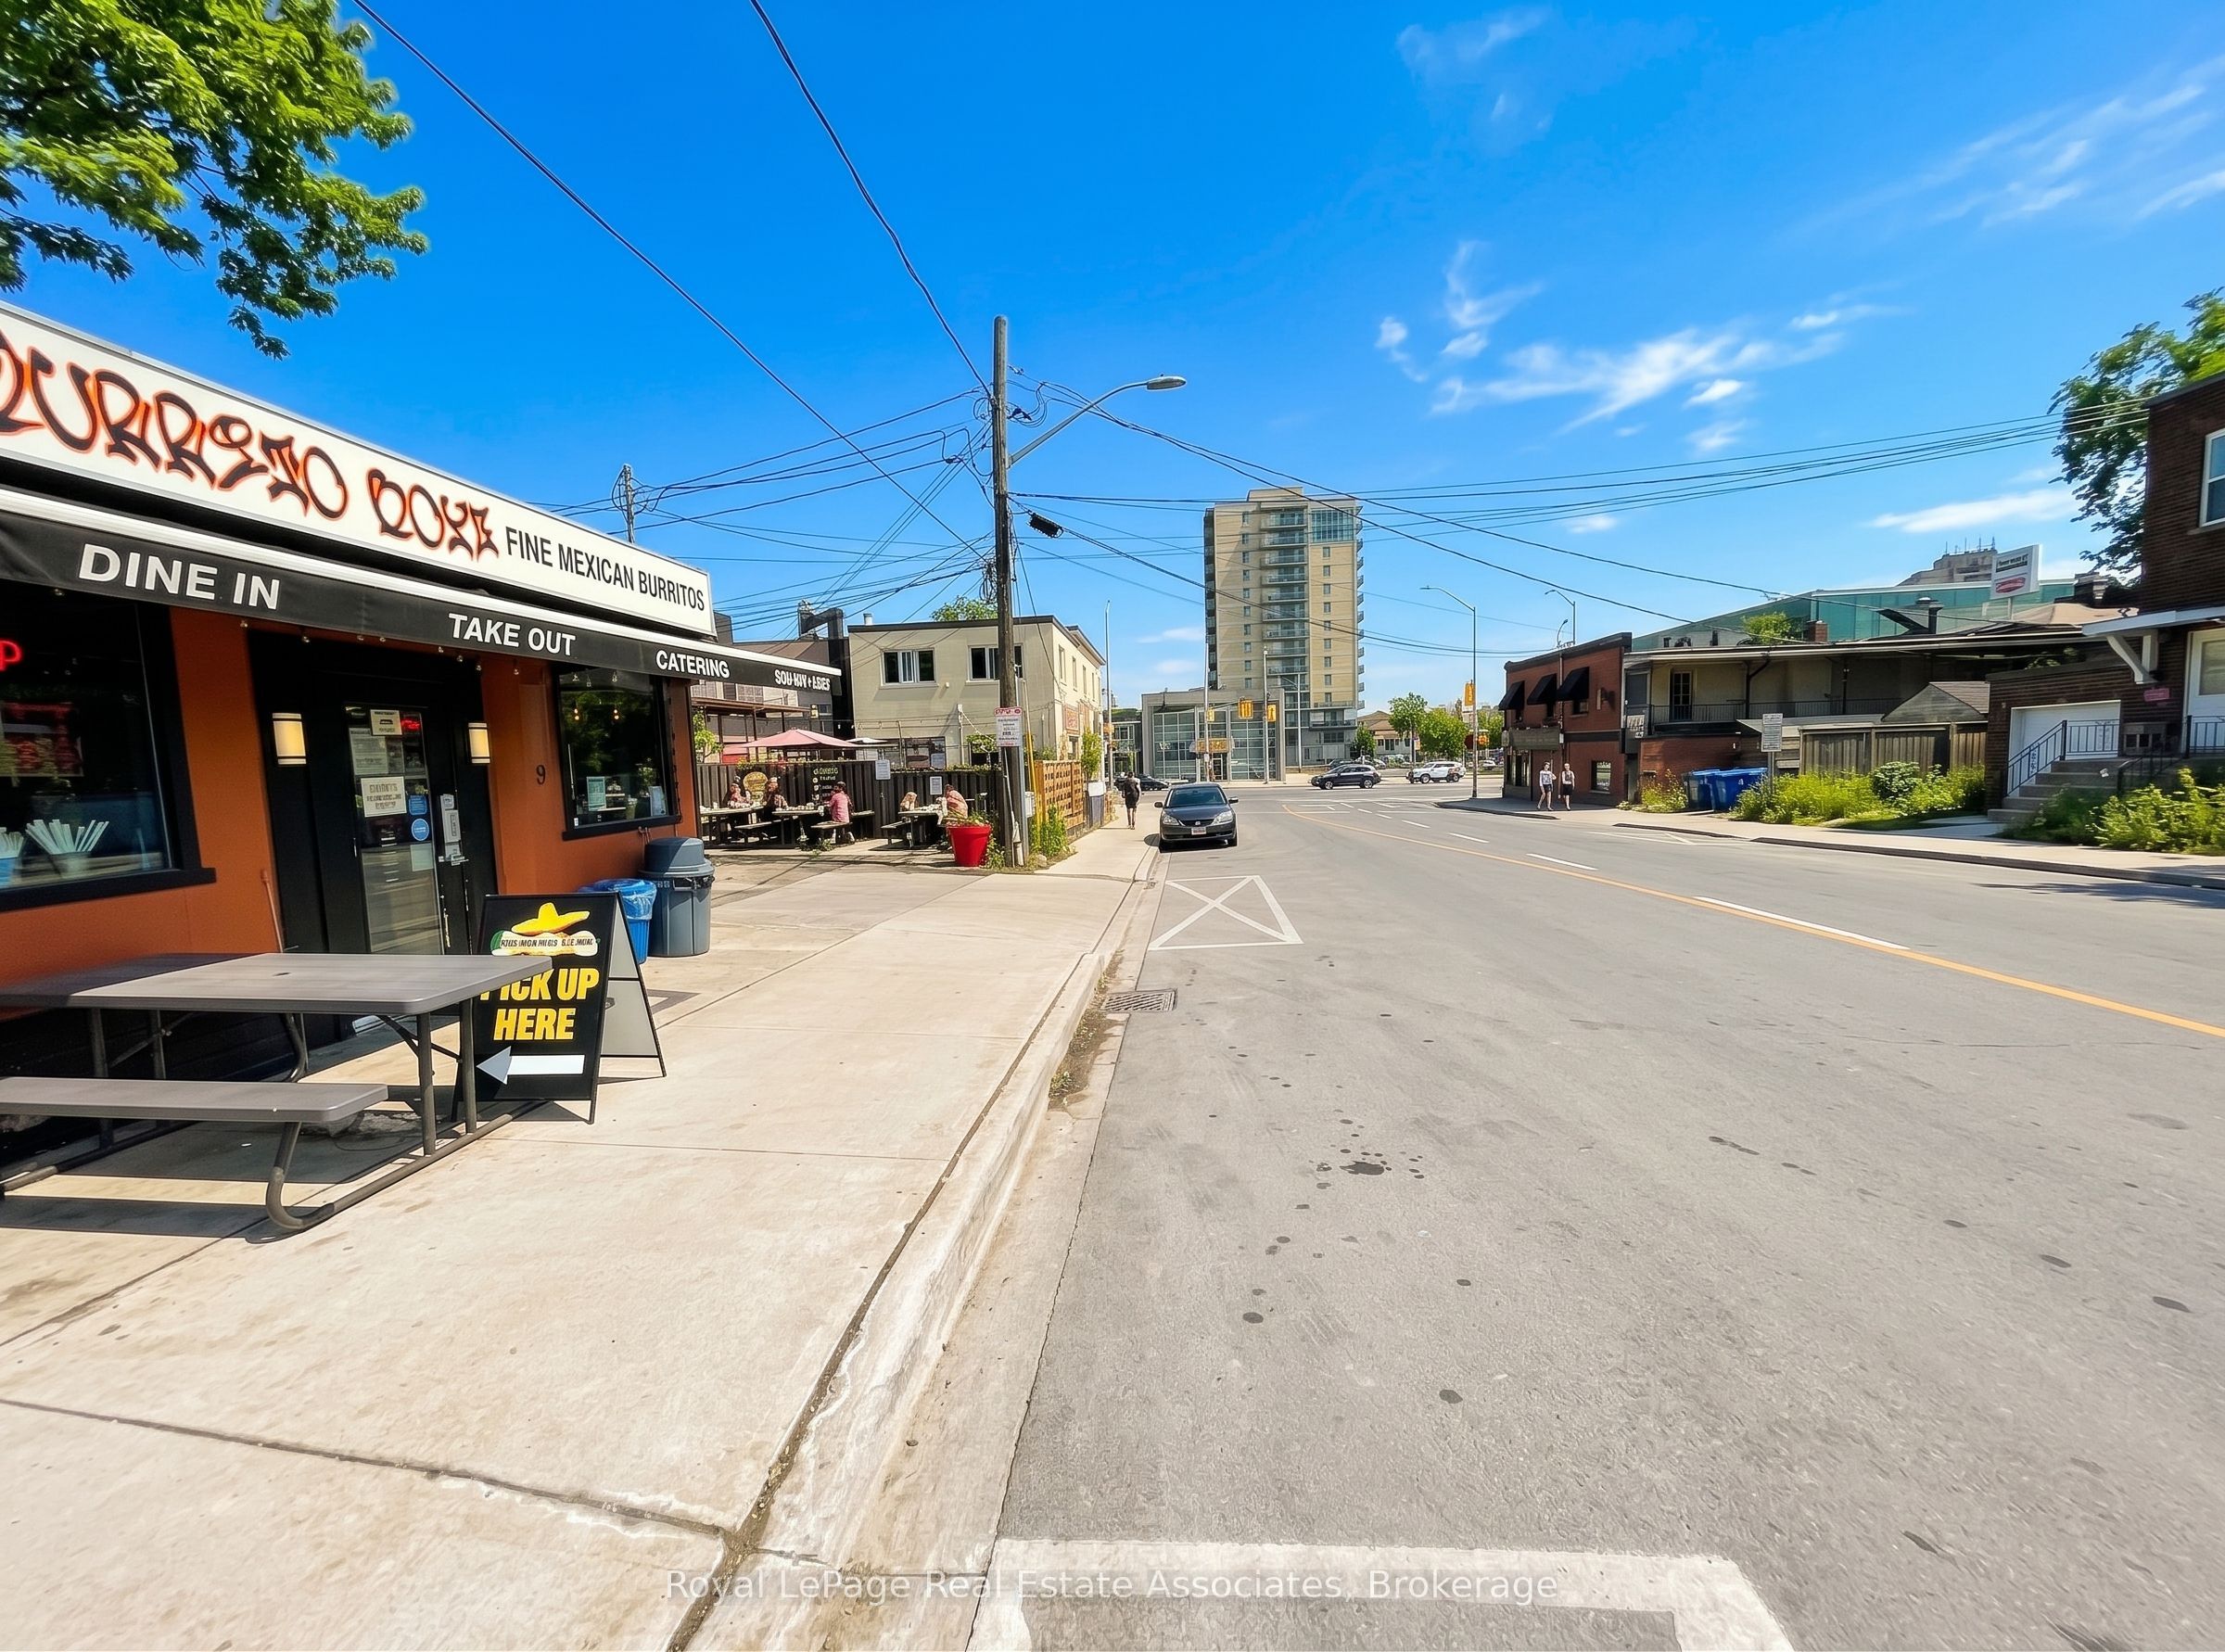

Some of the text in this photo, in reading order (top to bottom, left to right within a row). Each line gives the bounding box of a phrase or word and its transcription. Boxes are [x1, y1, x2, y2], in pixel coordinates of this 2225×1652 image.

[79, 543, 280, 610] DINE IN
[505, 527, 705, 611] FINE MEXICAN BURRITOS
[449, 613, 576, 656] TAKE OUT
[656, 649, 730, 679] CATERING
[536, 764, 546, 785] 9
[480, 968, 600, 1001] ICK UP
[493, 1008, 577, 1041] HERE
